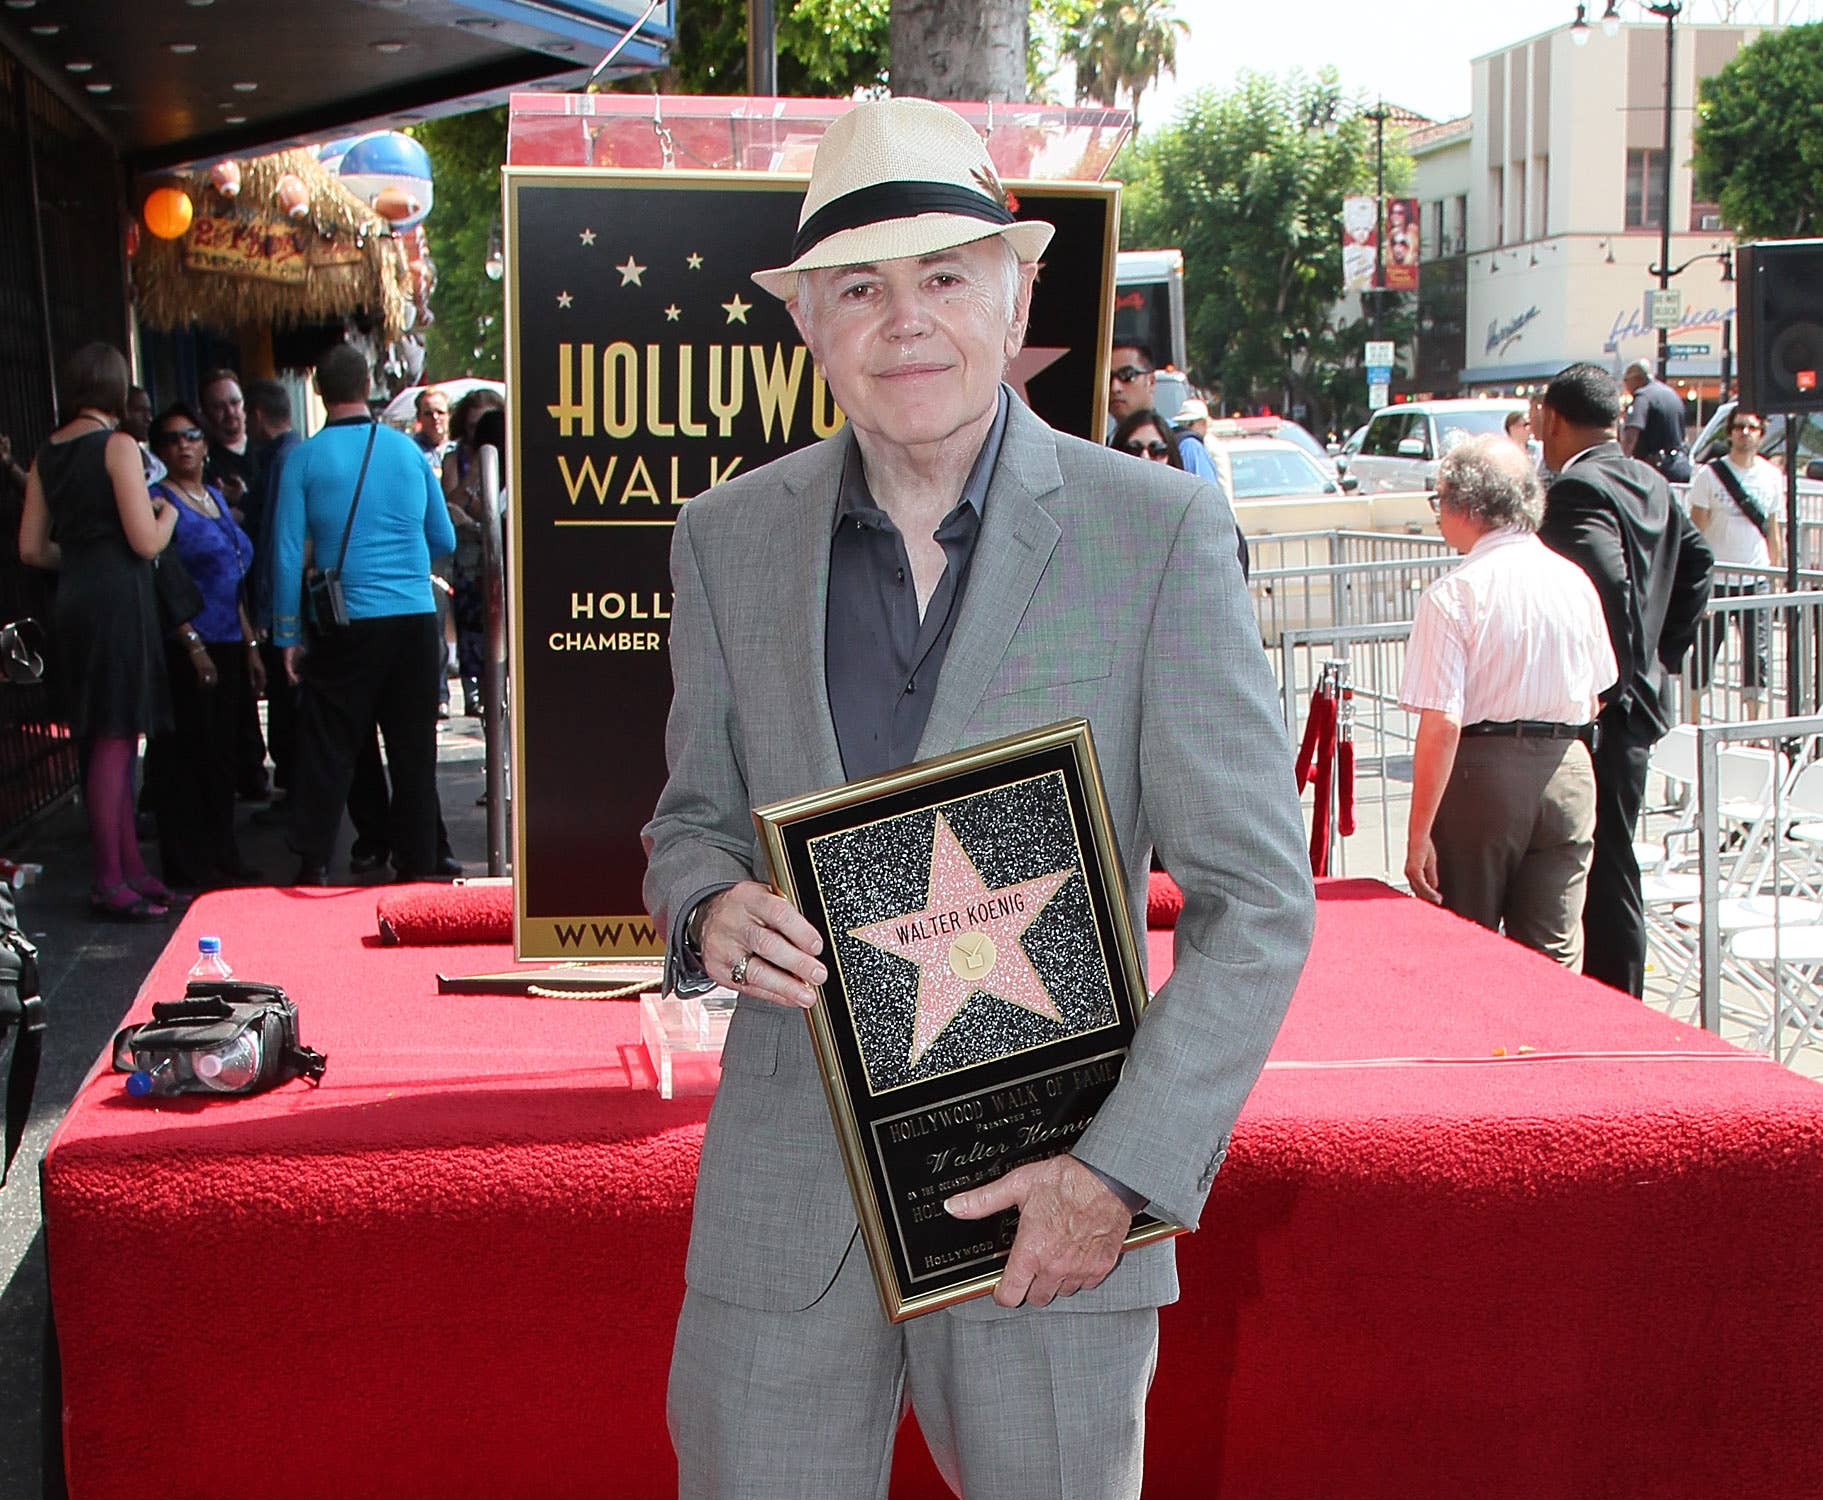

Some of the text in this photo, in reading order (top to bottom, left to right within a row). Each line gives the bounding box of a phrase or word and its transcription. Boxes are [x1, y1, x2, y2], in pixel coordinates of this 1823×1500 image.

[571, 592, 676, 619] HOLL
[549, 632, 660, 651] CHAMBER
[895, 893, 1025, 946] WALTER KOENIG
[889, 1061, 1116, 1144] HOLLYWOOD WALK OF FAME
[926, 1141, 1009, 1174] Walter
[924, 1240, 994, 1269] HOLLYWOOD
